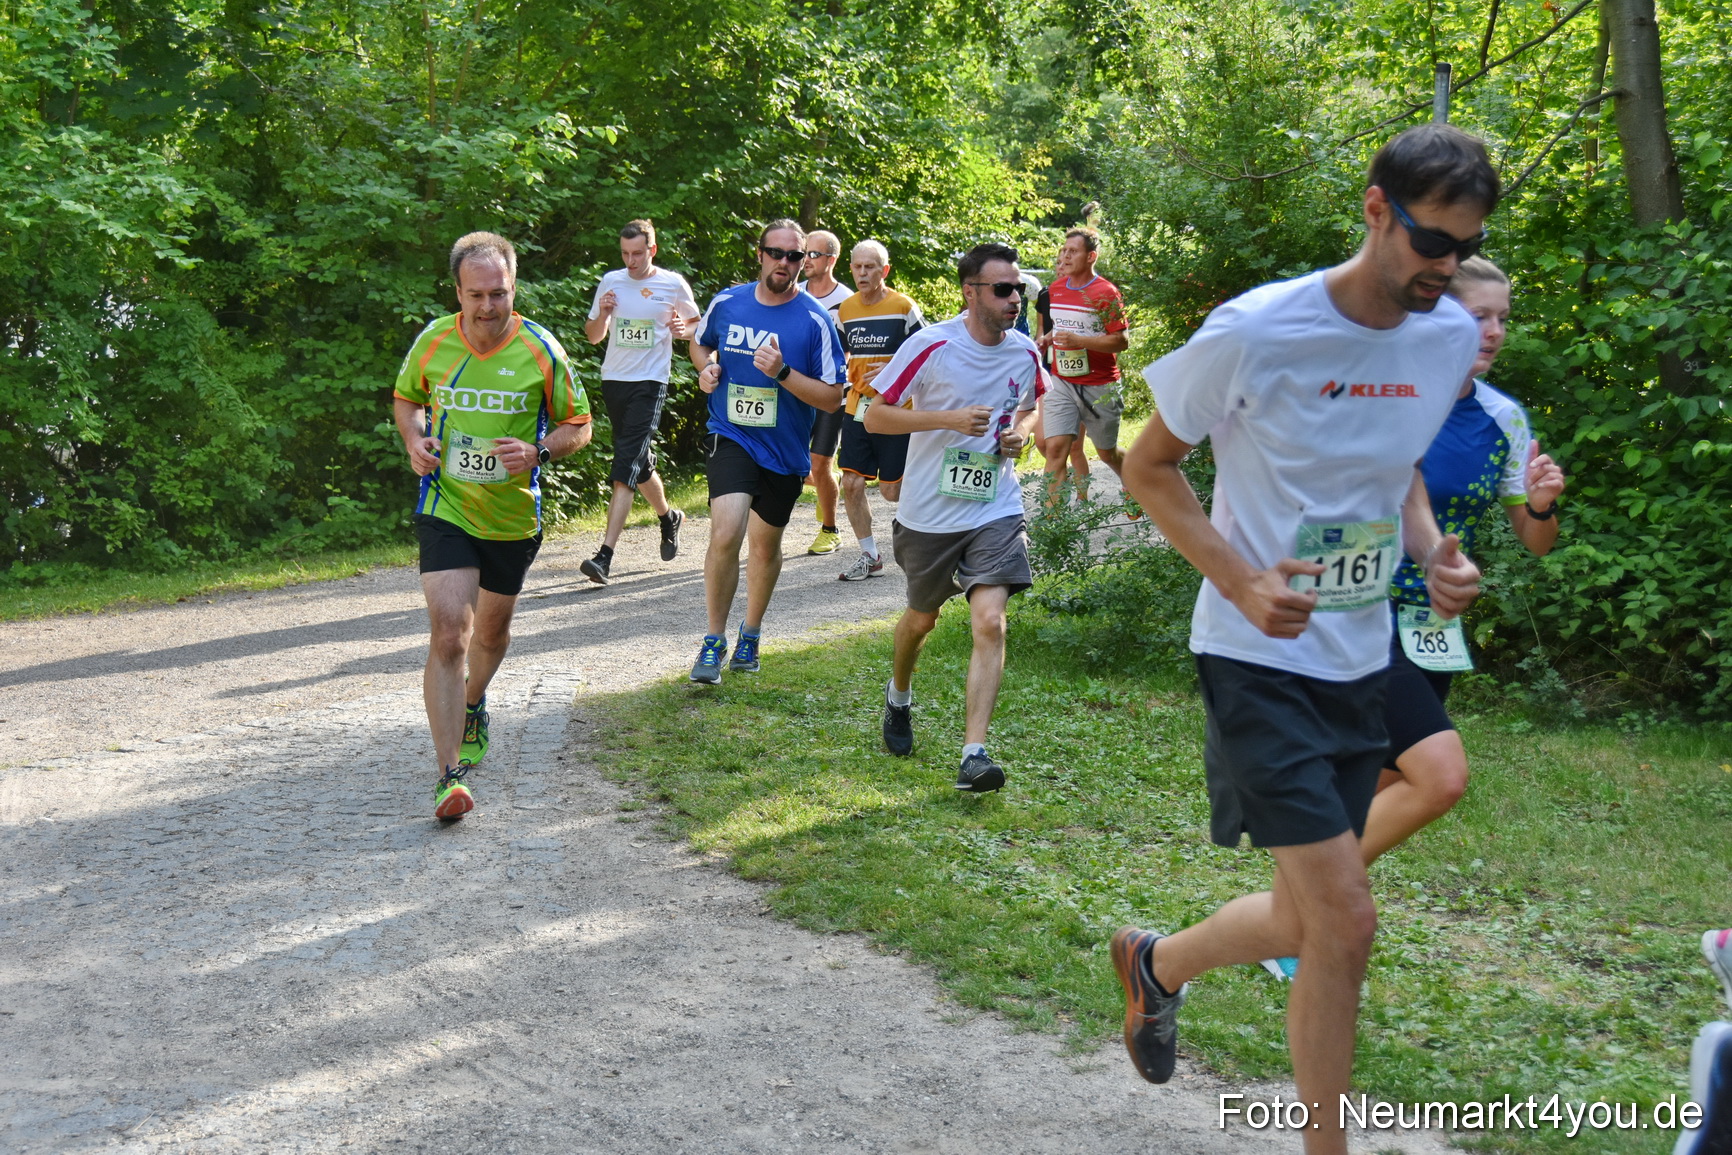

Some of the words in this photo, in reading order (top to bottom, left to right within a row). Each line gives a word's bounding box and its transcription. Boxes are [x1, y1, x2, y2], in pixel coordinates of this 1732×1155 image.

[1056, 318, 1085, 330] Petry
[620, 328, 648, 341] 1341
[726, 323, 780, 350] DVA
[851, 333, 890, 344] Fischer
[1058, 359, 1084, 369] 1829
[434, 383, 530, 415] BOCK
[1349, 384, 1420, 398] KLEBL
[735, 399, 765, 416] 676
[459, 451, 497, 472] 330
[949, 465, 992, 488] 1788
[1313, 549, 1383, 588] 1161
[1412, 630, 1449, 654] 268
